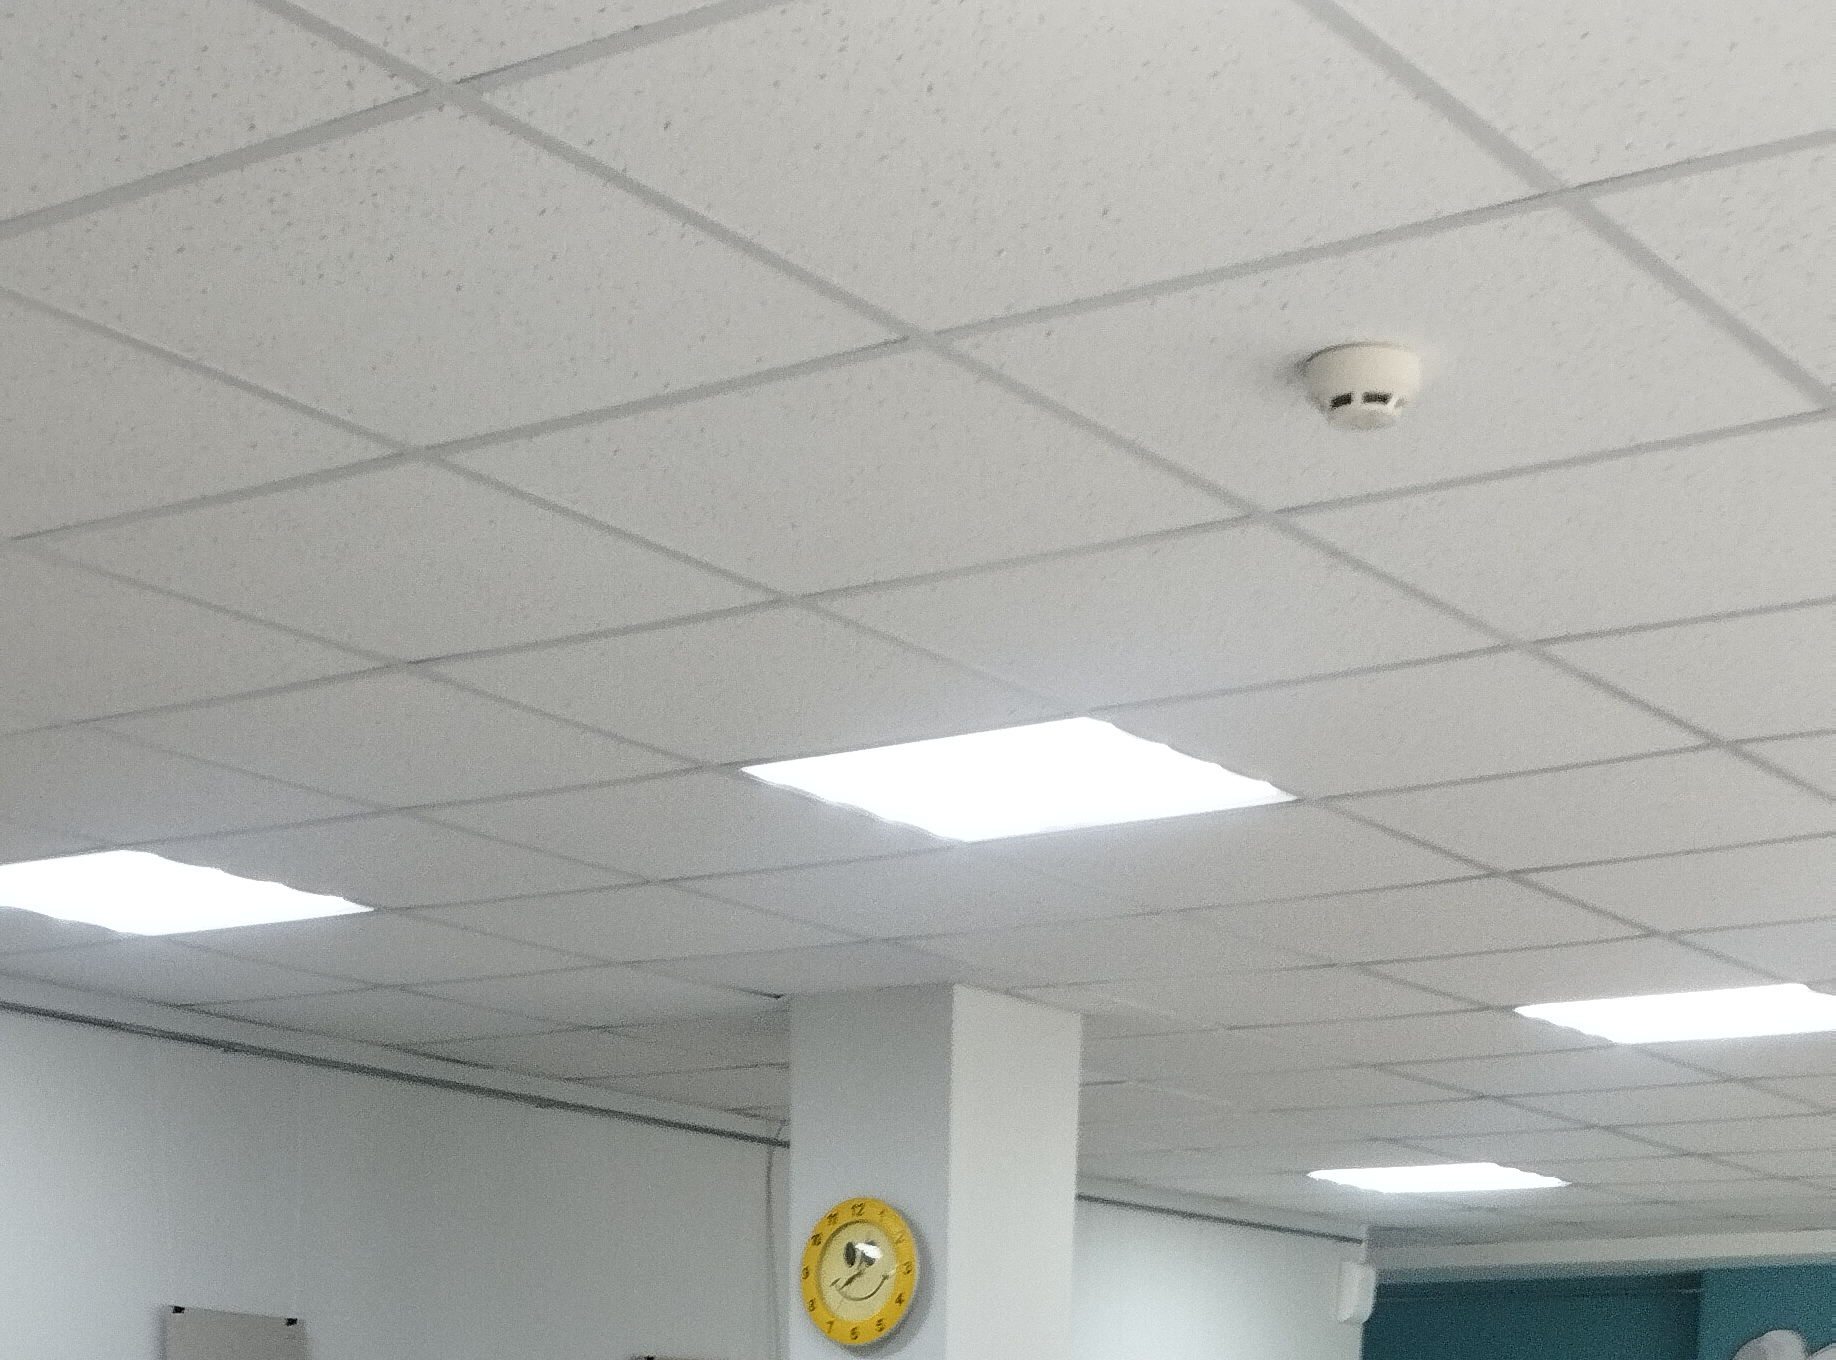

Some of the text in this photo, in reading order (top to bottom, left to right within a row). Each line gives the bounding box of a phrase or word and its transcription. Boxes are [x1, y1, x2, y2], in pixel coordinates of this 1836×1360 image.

[851, 1202, 866, 1217] 12
[894, 1292, 905, 1307] 4
[826, 1320, 835, 1334] 7
